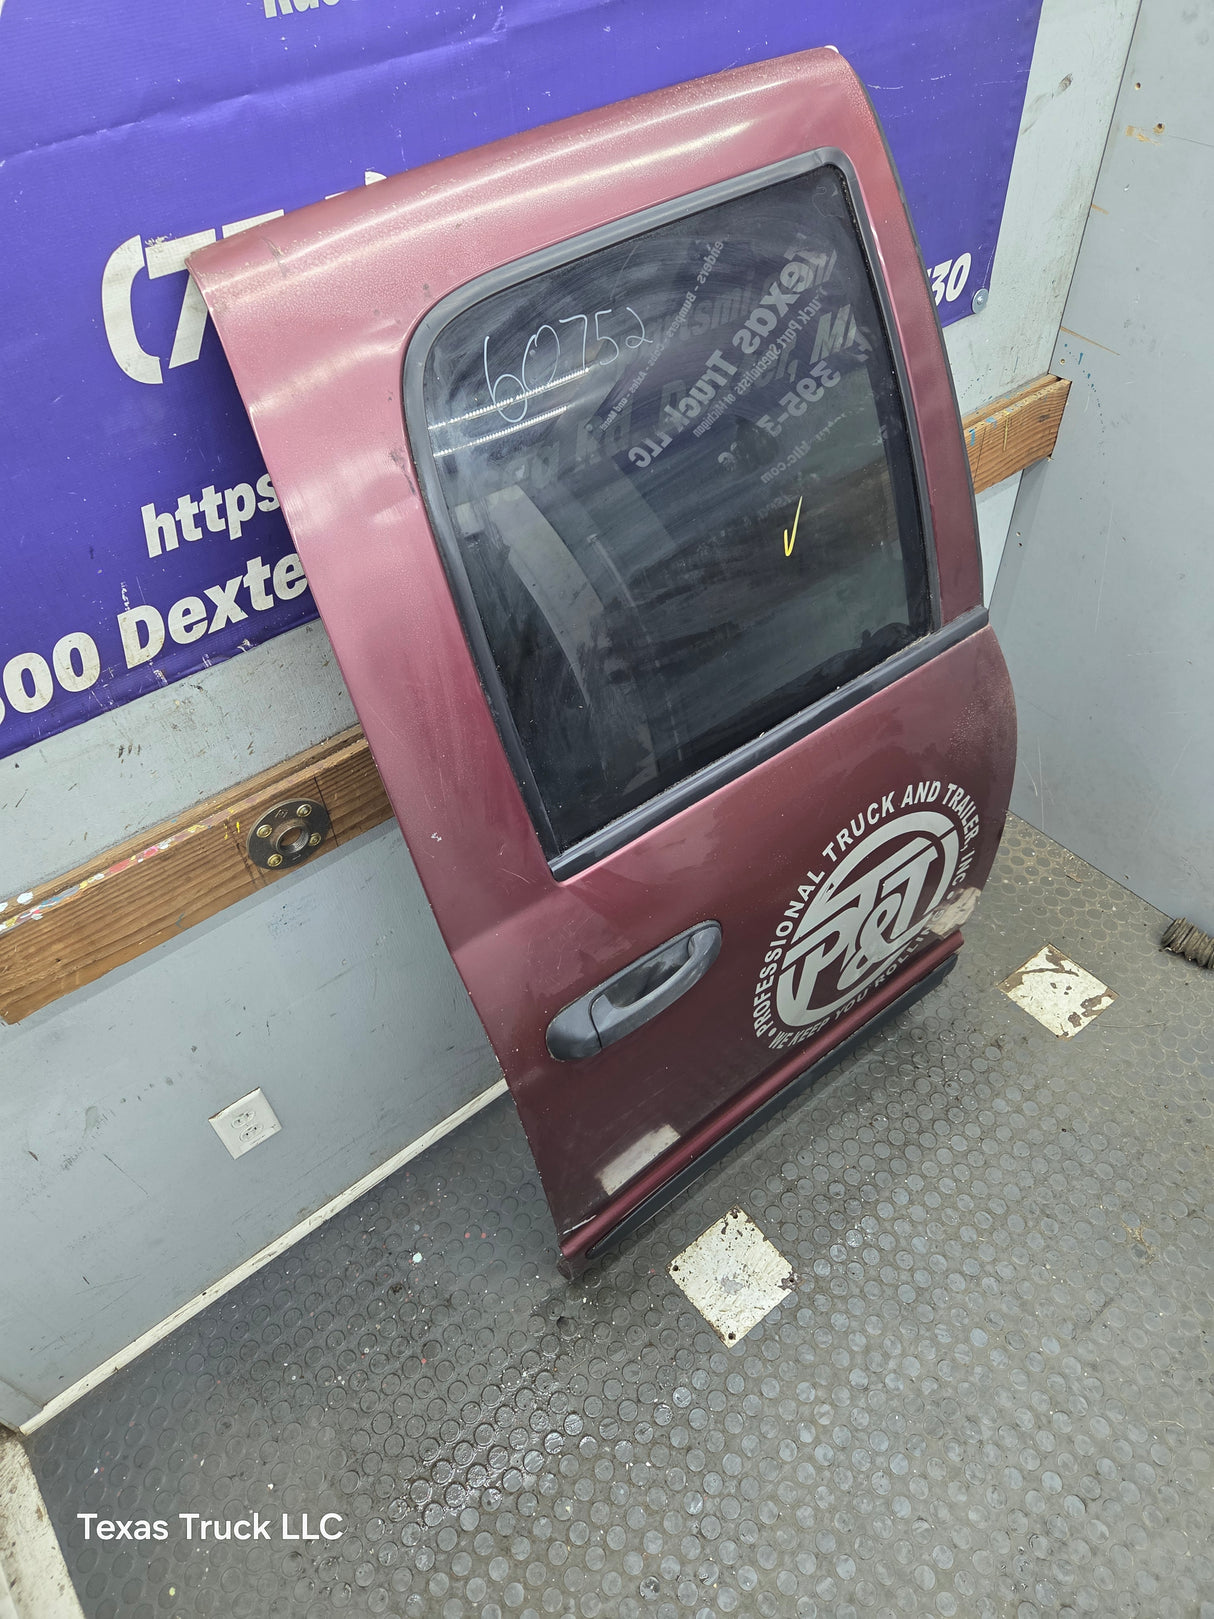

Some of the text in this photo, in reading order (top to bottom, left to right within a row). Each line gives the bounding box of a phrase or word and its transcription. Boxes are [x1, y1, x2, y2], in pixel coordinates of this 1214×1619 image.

[484, 306, 653, 423] 60752
[753, 869, 826, 1038] PROFESSIONAL
[822, 791, 896, 863] TRUCK
[900, 780, 942, 808] AND
[768, 1030, 795, 1050] WE
[789, 1016, 831, 1047] KEEP
